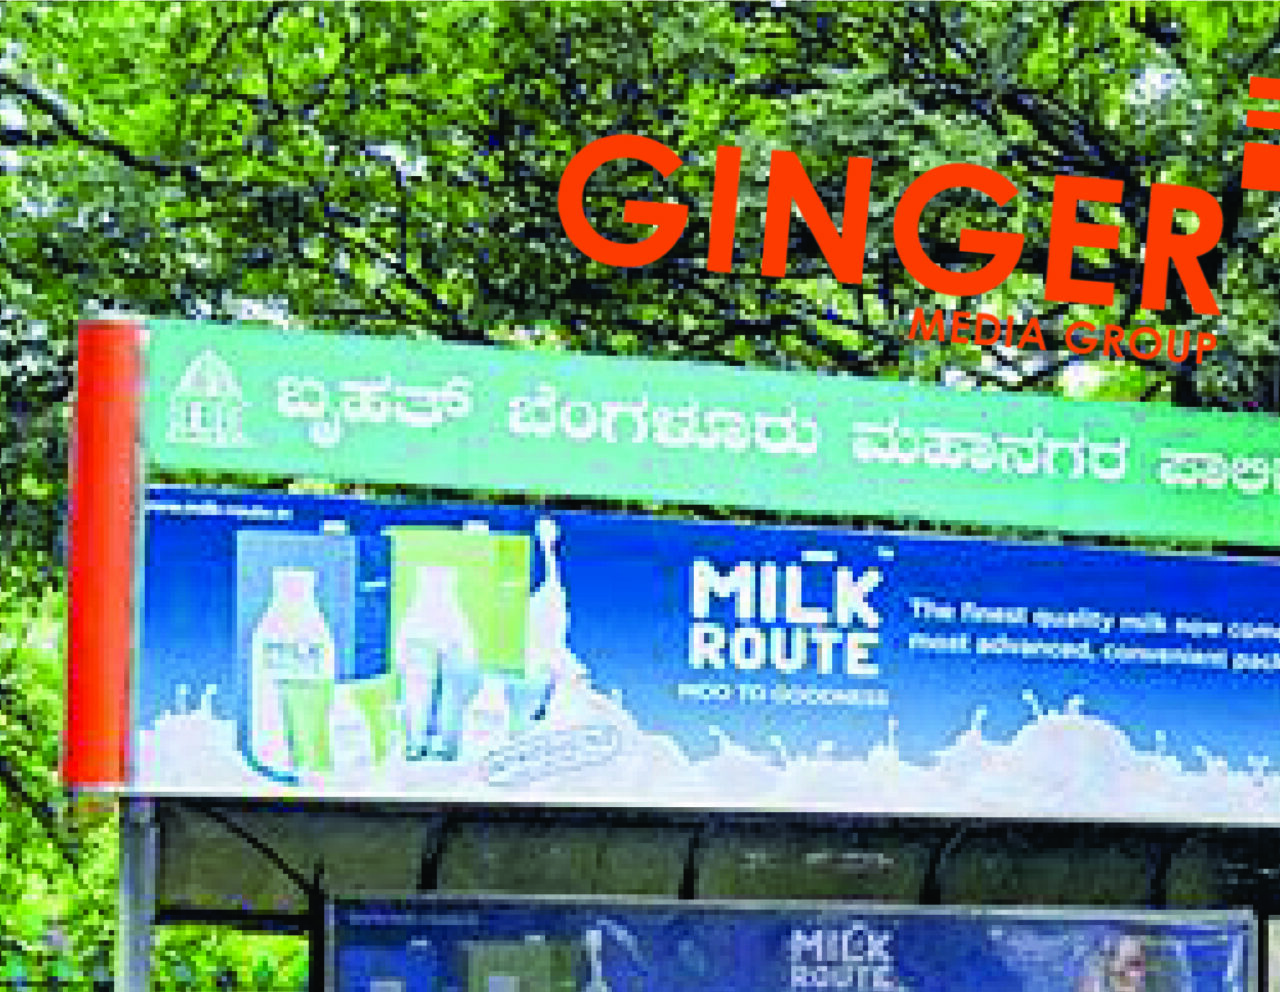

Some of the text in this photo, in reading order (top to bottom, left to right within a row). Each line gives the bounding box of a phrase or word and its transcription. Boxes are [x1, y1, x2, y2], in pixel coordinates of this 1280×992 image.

[276, 374, 474, 446] ಬೃಹತ್
[507, 384, 818, 455] ಬೆಂಗಳೂರು
[850, 417, 1129, 480] ಮಹಾನಗರ
[690, 560, 883, 628] MILK
[908, 597, 956, 622] The
[960, 600, 1029, 624] finest
[1031, 607, 1115, 634] quality
[1119, 612, 1168, 634] milk
[1175, 617, 1223, 638] now
[689, 622, 880, 677] ROUTE
[908, 633, 969, 655] most
[1102, 644, 1228, 669] convenient
[789, 928, 893, 964] MILK
[789, 963, 896, 992] ROUTE
